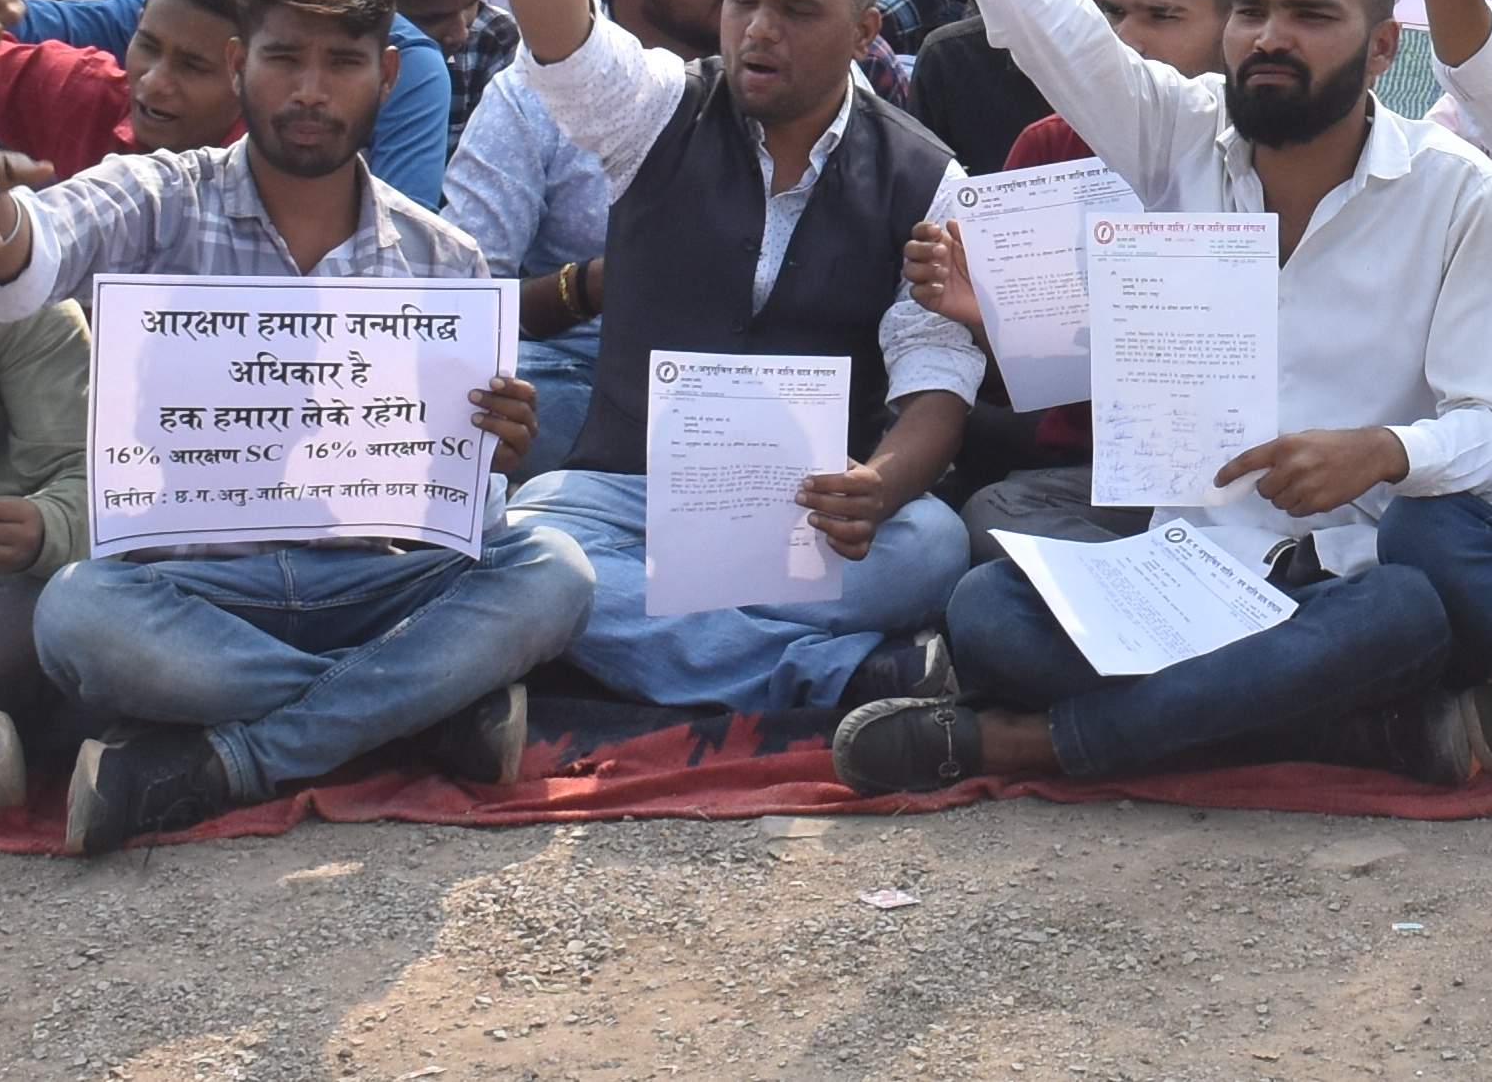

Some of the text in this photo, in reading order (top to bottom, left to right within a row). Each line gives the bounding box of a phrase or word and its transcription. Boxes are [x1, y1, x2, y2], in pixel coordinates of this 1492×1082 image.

[141, 303, 462, 343] आरक्षण हमारा जन्मसिद्ध
[228, 351, 372, 389] अधिकार है
[159, 405, 207, 433] हक
[213, 405, 294, 433] हमारा
[300, 398, 354, 430] लेके
